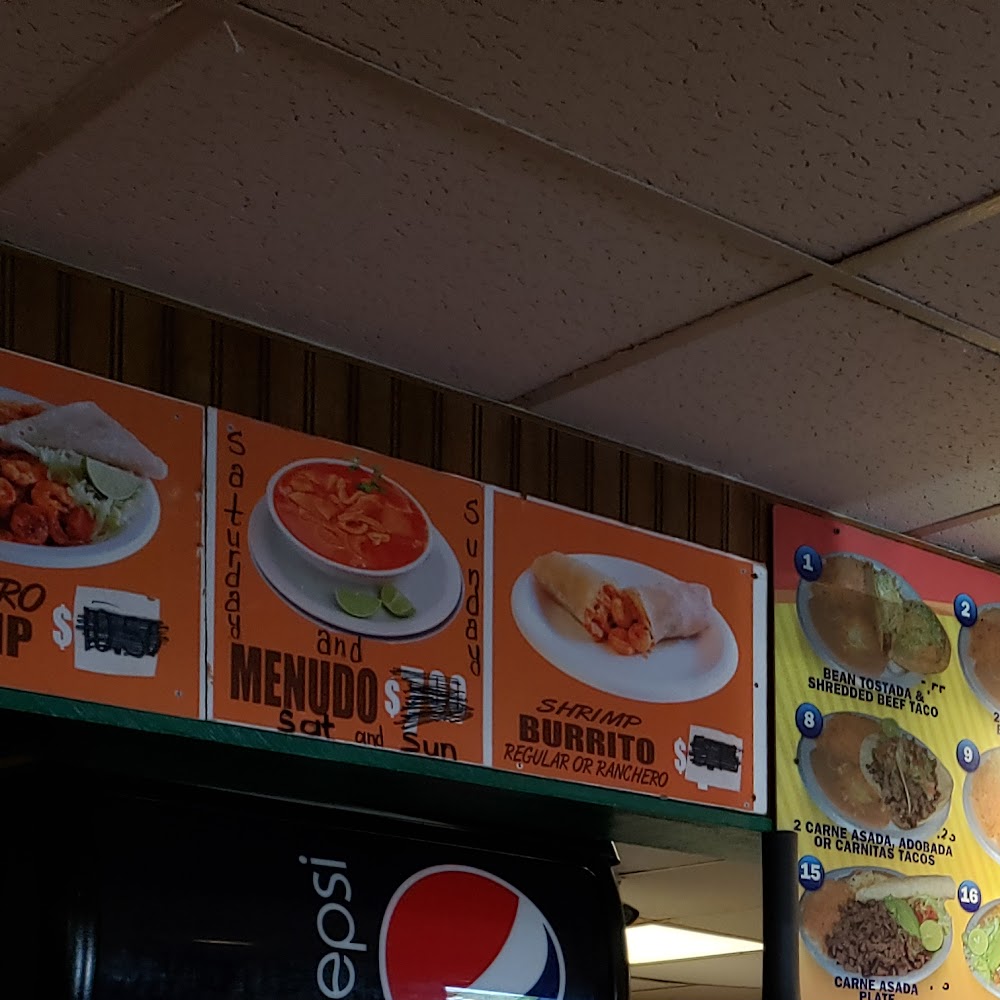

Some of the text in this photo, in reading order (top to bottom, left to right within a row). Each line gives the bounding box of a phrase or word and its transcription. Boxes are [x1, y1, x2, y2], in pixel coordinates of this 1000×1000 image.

[224, 430, 246, 639] Saturday
[802, 553, 814, 572] 1
[463, 499, 481, 676] Sunday
[961, 601, 971, 618] 2
[0, 613, 32, 657] P
[317, 629, 363, 662] and
[230, 642, 378, 724] MENUDO
[808, 677, 939, 718] SHREDDED BEEF TACO
[823, 668, 924, 703] BEAN TOSTADA &
[536, 698, 642, 729] SHRIMP
[804, 711, 816, 728] 8
[277, 709, 457, 760] Sat and Sun
[519, 714, 654, 765] BURRITO
[504, 743, 669, 788] REGULAR OR RANCHERO
[963, 747, 973, 763] 9
[794, 820, 953, 857] 2 CARNE ASADA, ADOBADA
[814, 836, 936, 866] OR CARNITAS TACOS
[800, 861, 821, 881] 15
[960, 888, 979, 904] 16
[834, 976, 918, 996] CARNE ASADA
